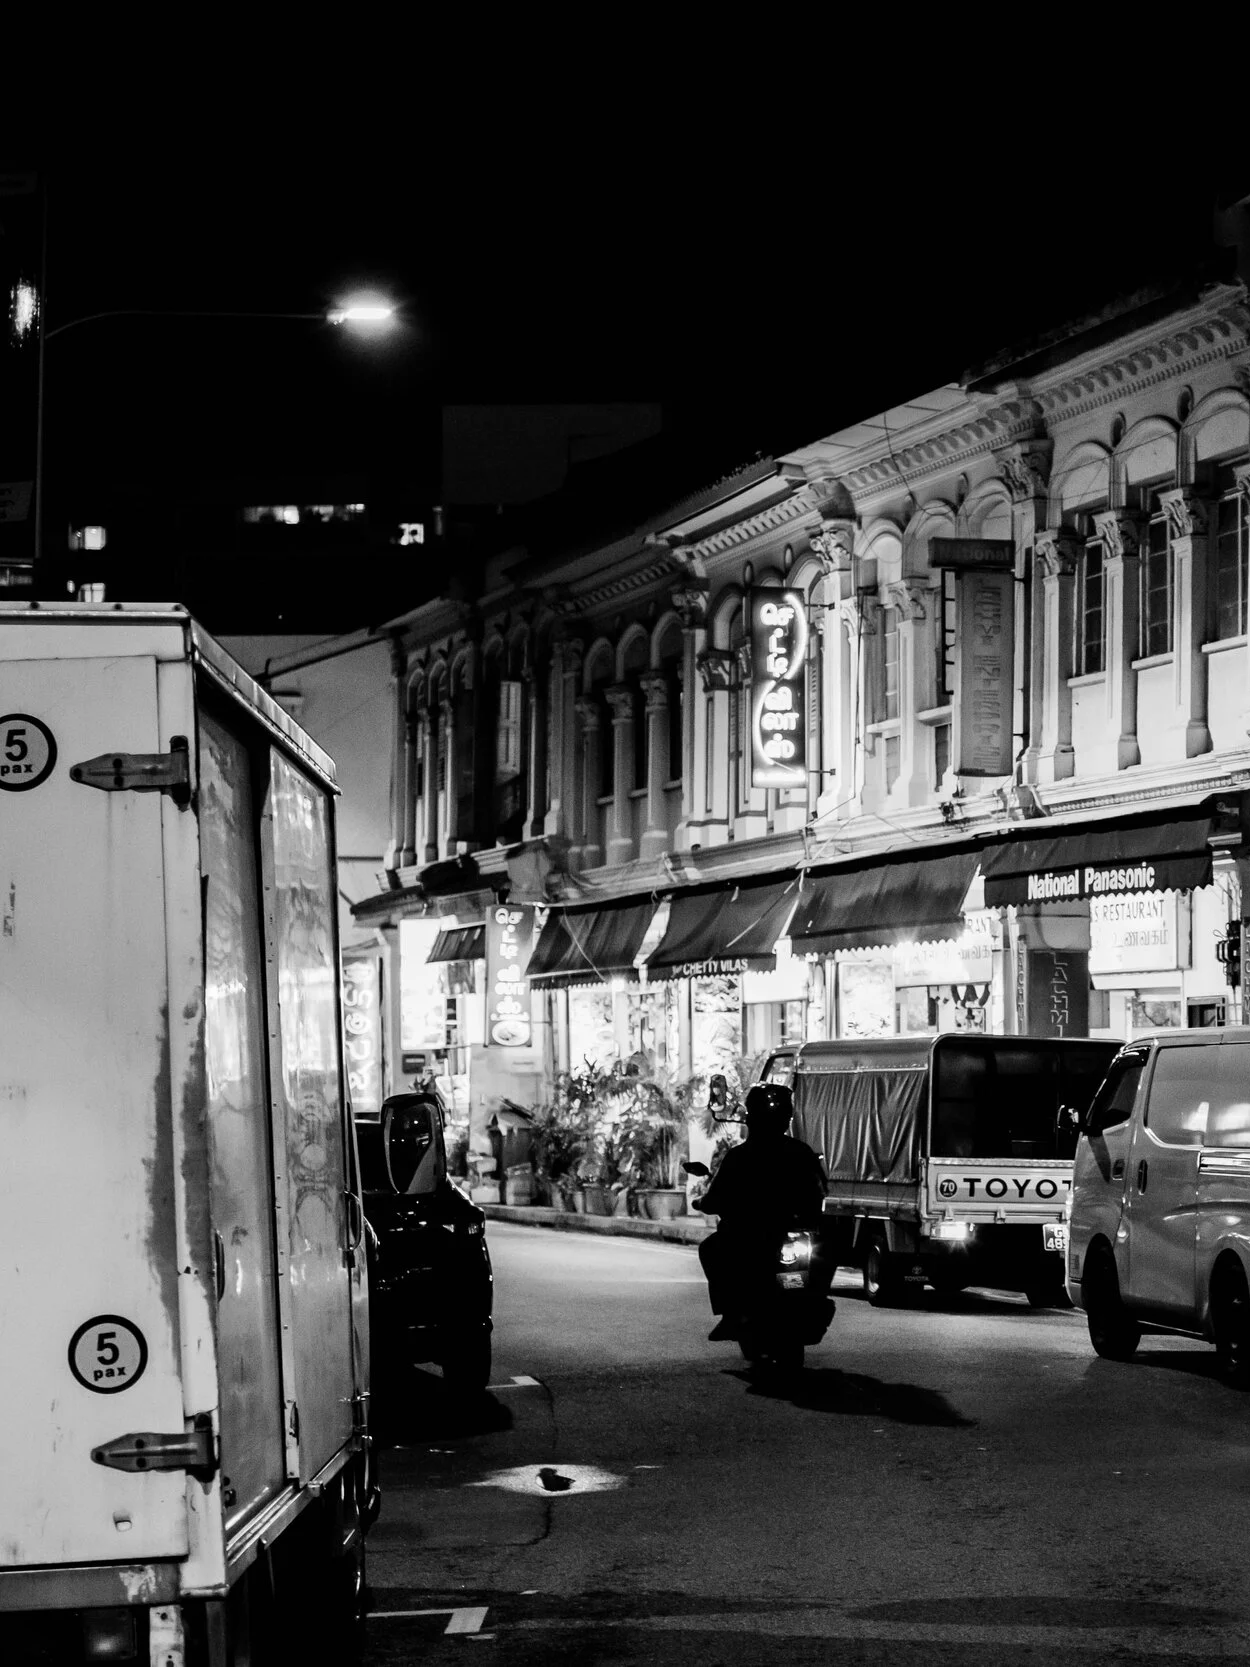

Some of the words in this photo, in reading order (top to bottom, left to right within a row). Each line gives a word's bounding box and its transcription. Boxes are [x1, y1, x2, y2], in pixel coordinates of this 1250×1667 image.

[5, 729, 28, 762] 5
[1, 764, 33, 776] pax
[1028, 869, 1079, 900] National
[1084, 861, 1155, 892] Panasonic
[1103, 899, 1165, 922] RESTAURANT
[682, 959, 719, 976] CHETTY
[720, 958, 748, 973] VILAS
[942, 1182, 955, 1192] 70
[963, 1177, 1072, 1199] TOYOT
[97, 1331, 120, 1366] 5
[93, 1366, 126, 1382] pax
